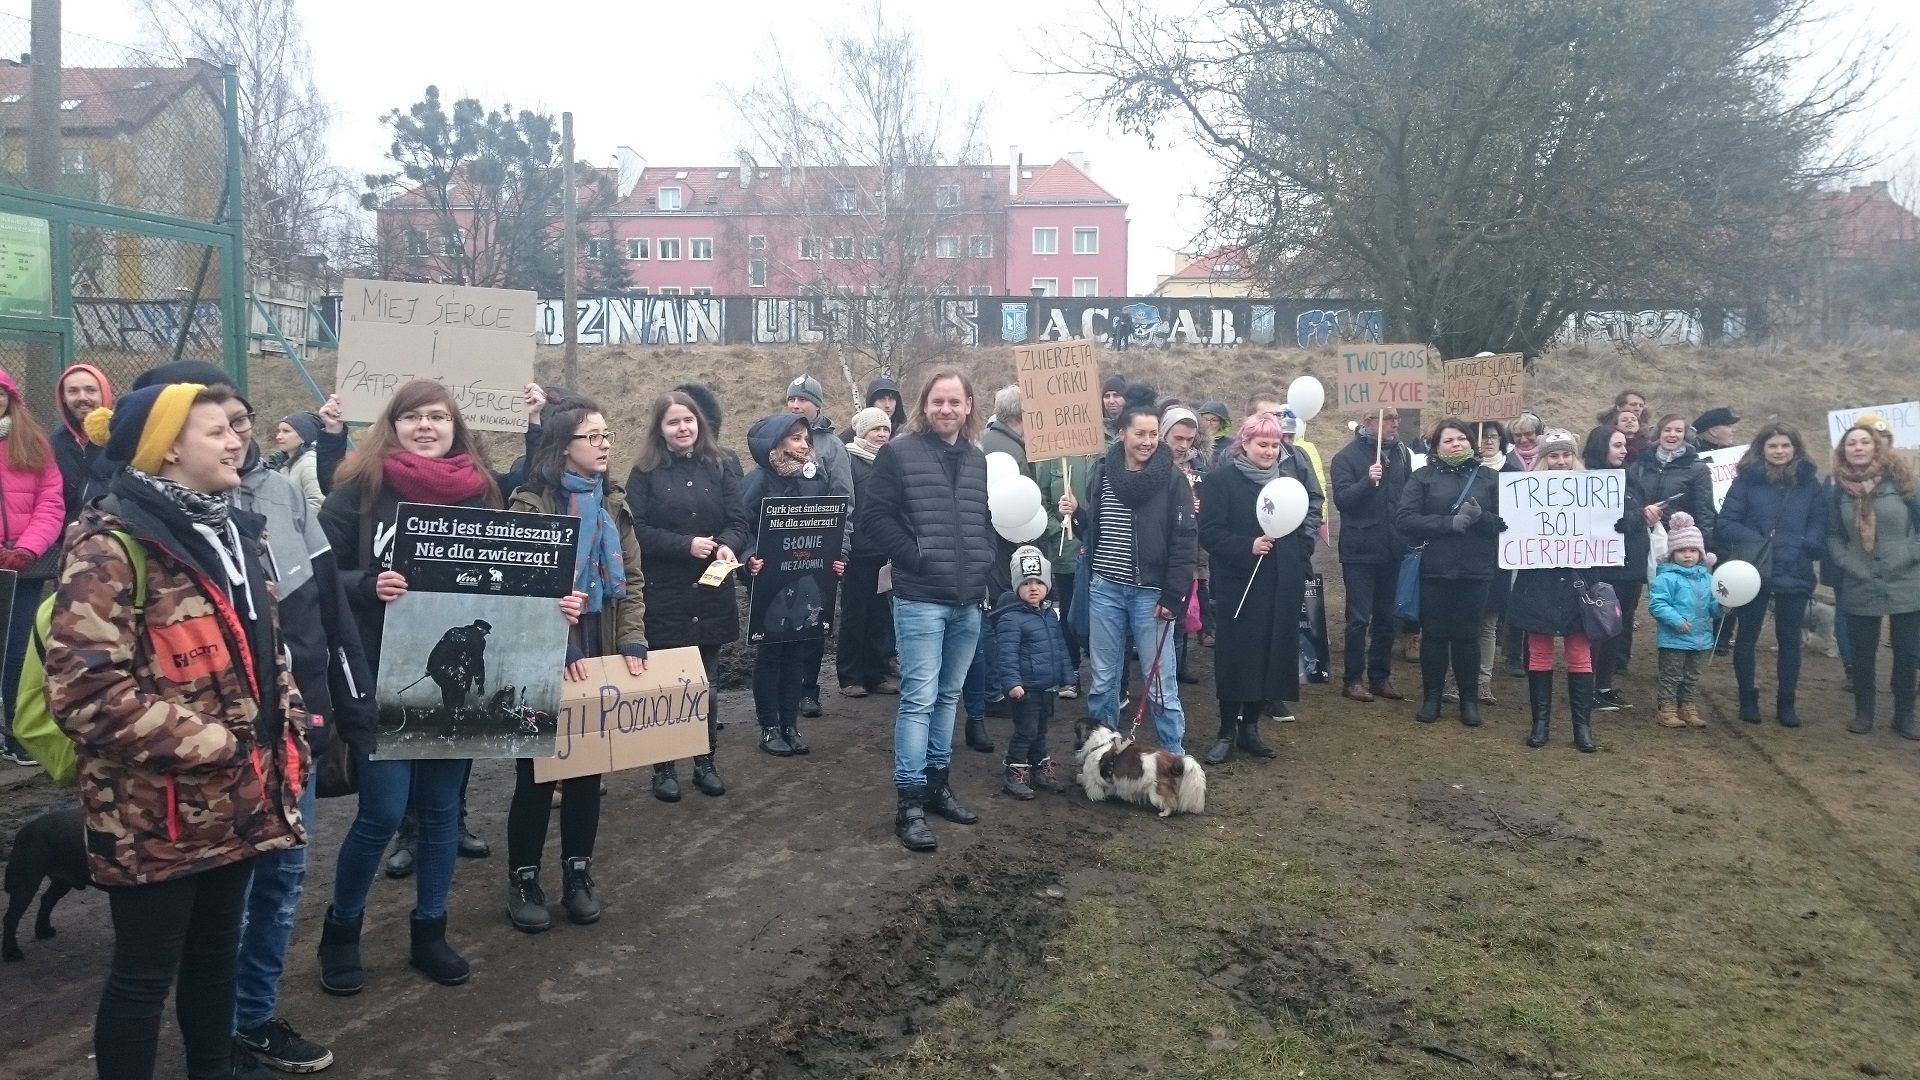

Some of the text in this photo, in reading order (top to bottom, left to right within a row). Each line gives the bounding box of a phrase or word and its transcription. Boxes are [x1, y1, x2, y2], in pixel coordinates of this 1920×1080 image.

[426, 295, 514, 328] SERCE
[1020, 344, 1093, 371] ZWIERZĘTA
[1390, 350, 1424, 369] GŁOS
[1024, 370, 1088, 400] W CYRKU
[1344, 383, 1370, 405] ICH
[1448, 378, 1479, 400] KARY
[1488, 375, 1517, 397] ONE
[480, 414, 527, 428] MICKIEWICZ
[1028, 402, 1091, 430] TO BRAK
[1030, 426, 1098, 454] SZACUNKU
[1505, 475, 1620, 508] TRESURA
[766, 503, 845, 515] Cyrk jest śmieszny ?
[1535, 507, 1584, 536] BÓL
[406, 516, 574, 543] Cyrk jest śmieszny ?
[769, 519, 784, 528] Nie
[785, 518, 799, 527] dla
[799, 517, 835, 527] zwierząt
[414, 542, 559, 567] Nie dla zwierząt !
[782, 535, 823, 550] SŁONIE
[1504, 538, 1619, 566] CIERPIENIE
[780, 561, 792, 571] NIE
